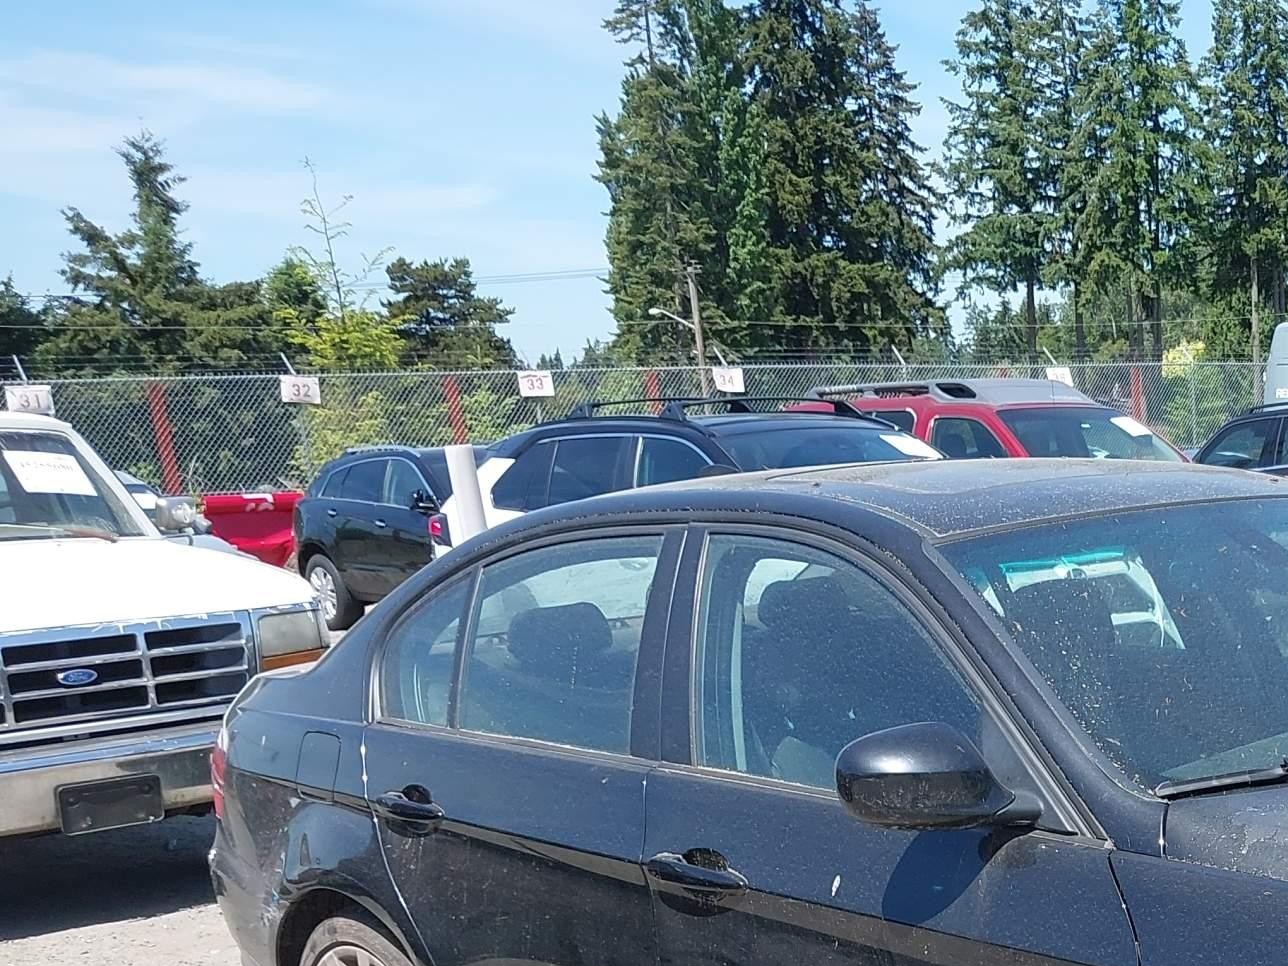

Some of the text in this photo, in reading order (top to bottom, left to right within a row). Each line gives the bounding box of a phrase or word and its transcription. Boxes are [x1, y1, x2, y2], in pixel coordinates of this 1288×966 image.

[527, 377, 544, 391] 33
[720, 374, 734, 386] 34
[292, 383, 311, 397] 32
[20, 393, 41, 409] 31
